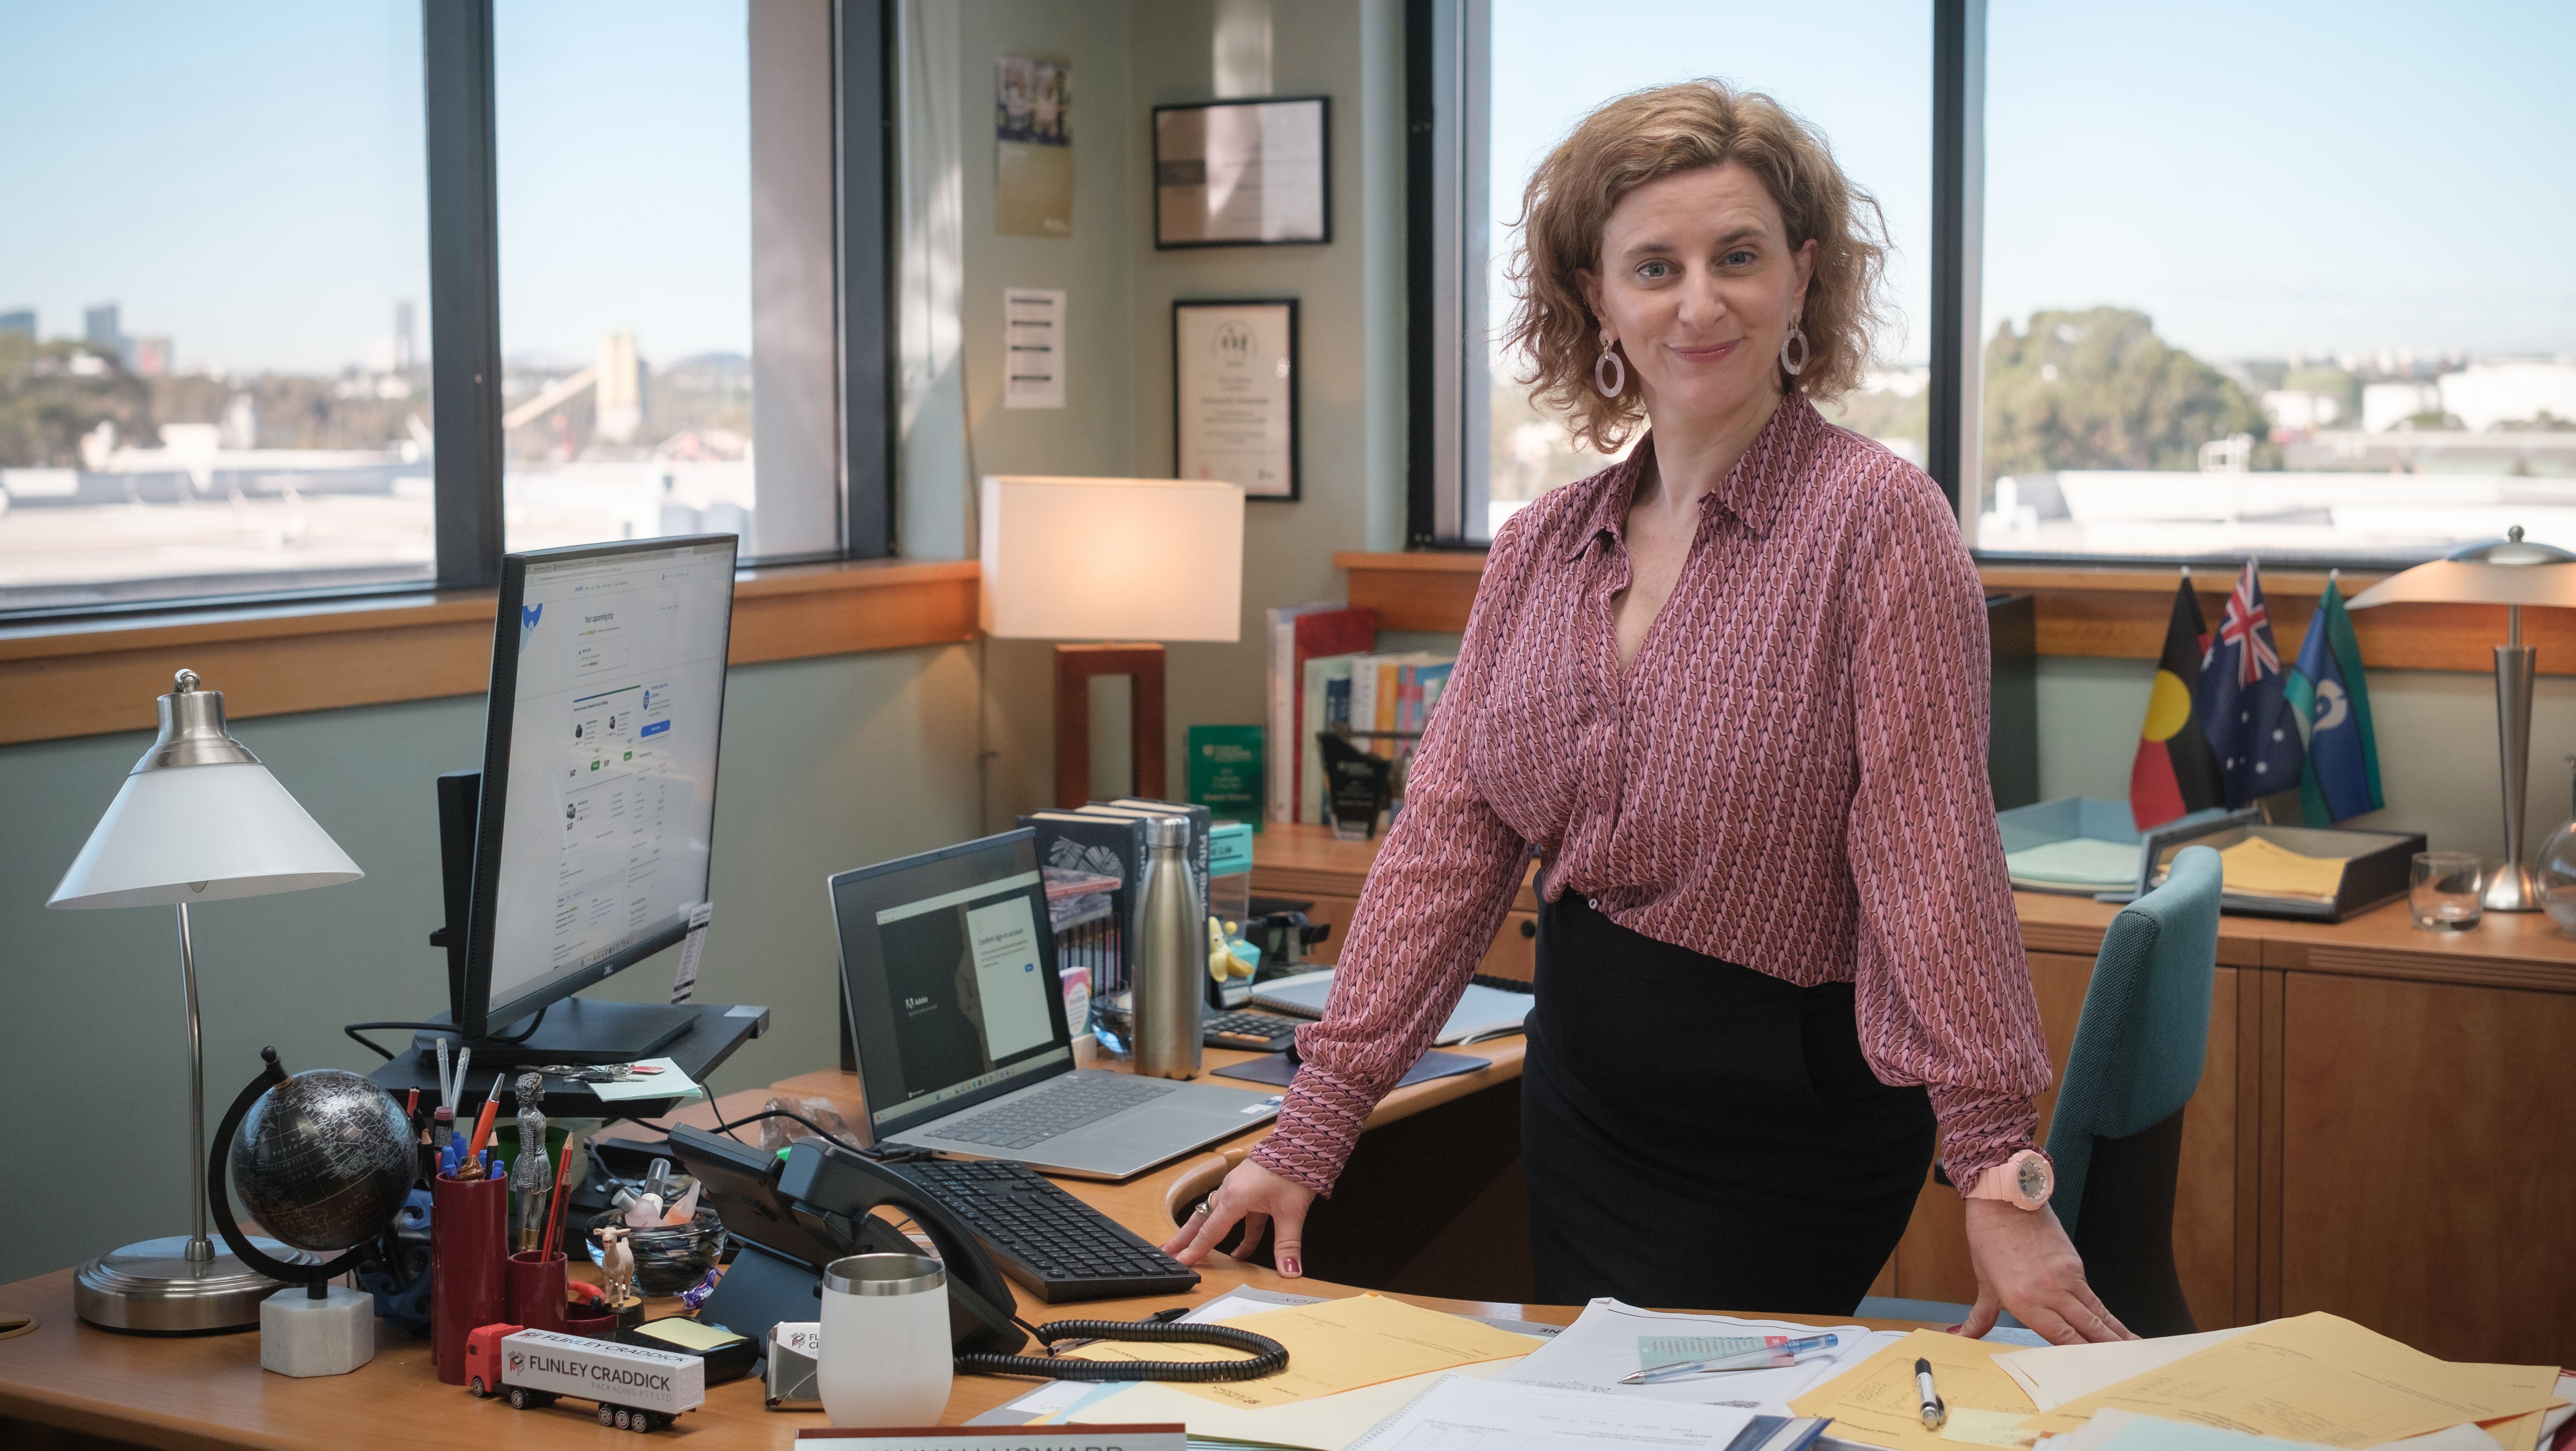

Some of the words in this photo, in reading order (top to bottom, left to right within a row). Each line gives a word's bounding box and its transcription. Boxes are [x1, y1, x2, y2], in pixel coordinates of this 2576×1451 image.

[915, 996, 928, 1005] Adobe
[272, 1144, 298, 1156] NORTH
[270, 1156, 304, 1171] ATLANTIC
[281, 1171, 308, 1183] OCEAN
[542, 1335, 604, 1348] FLINLEY
[605, 1345, 690, 1362] CRADDICK
[530, 1355, 588, 1377] FLINLEY
[591, 1366, 670, 1392] CRADDICK
[592, 1381, 637, 1396] PACKAGING
[639, 1389, 654, 1399] PTY
[657, 1392, 672, 1402] LTD
